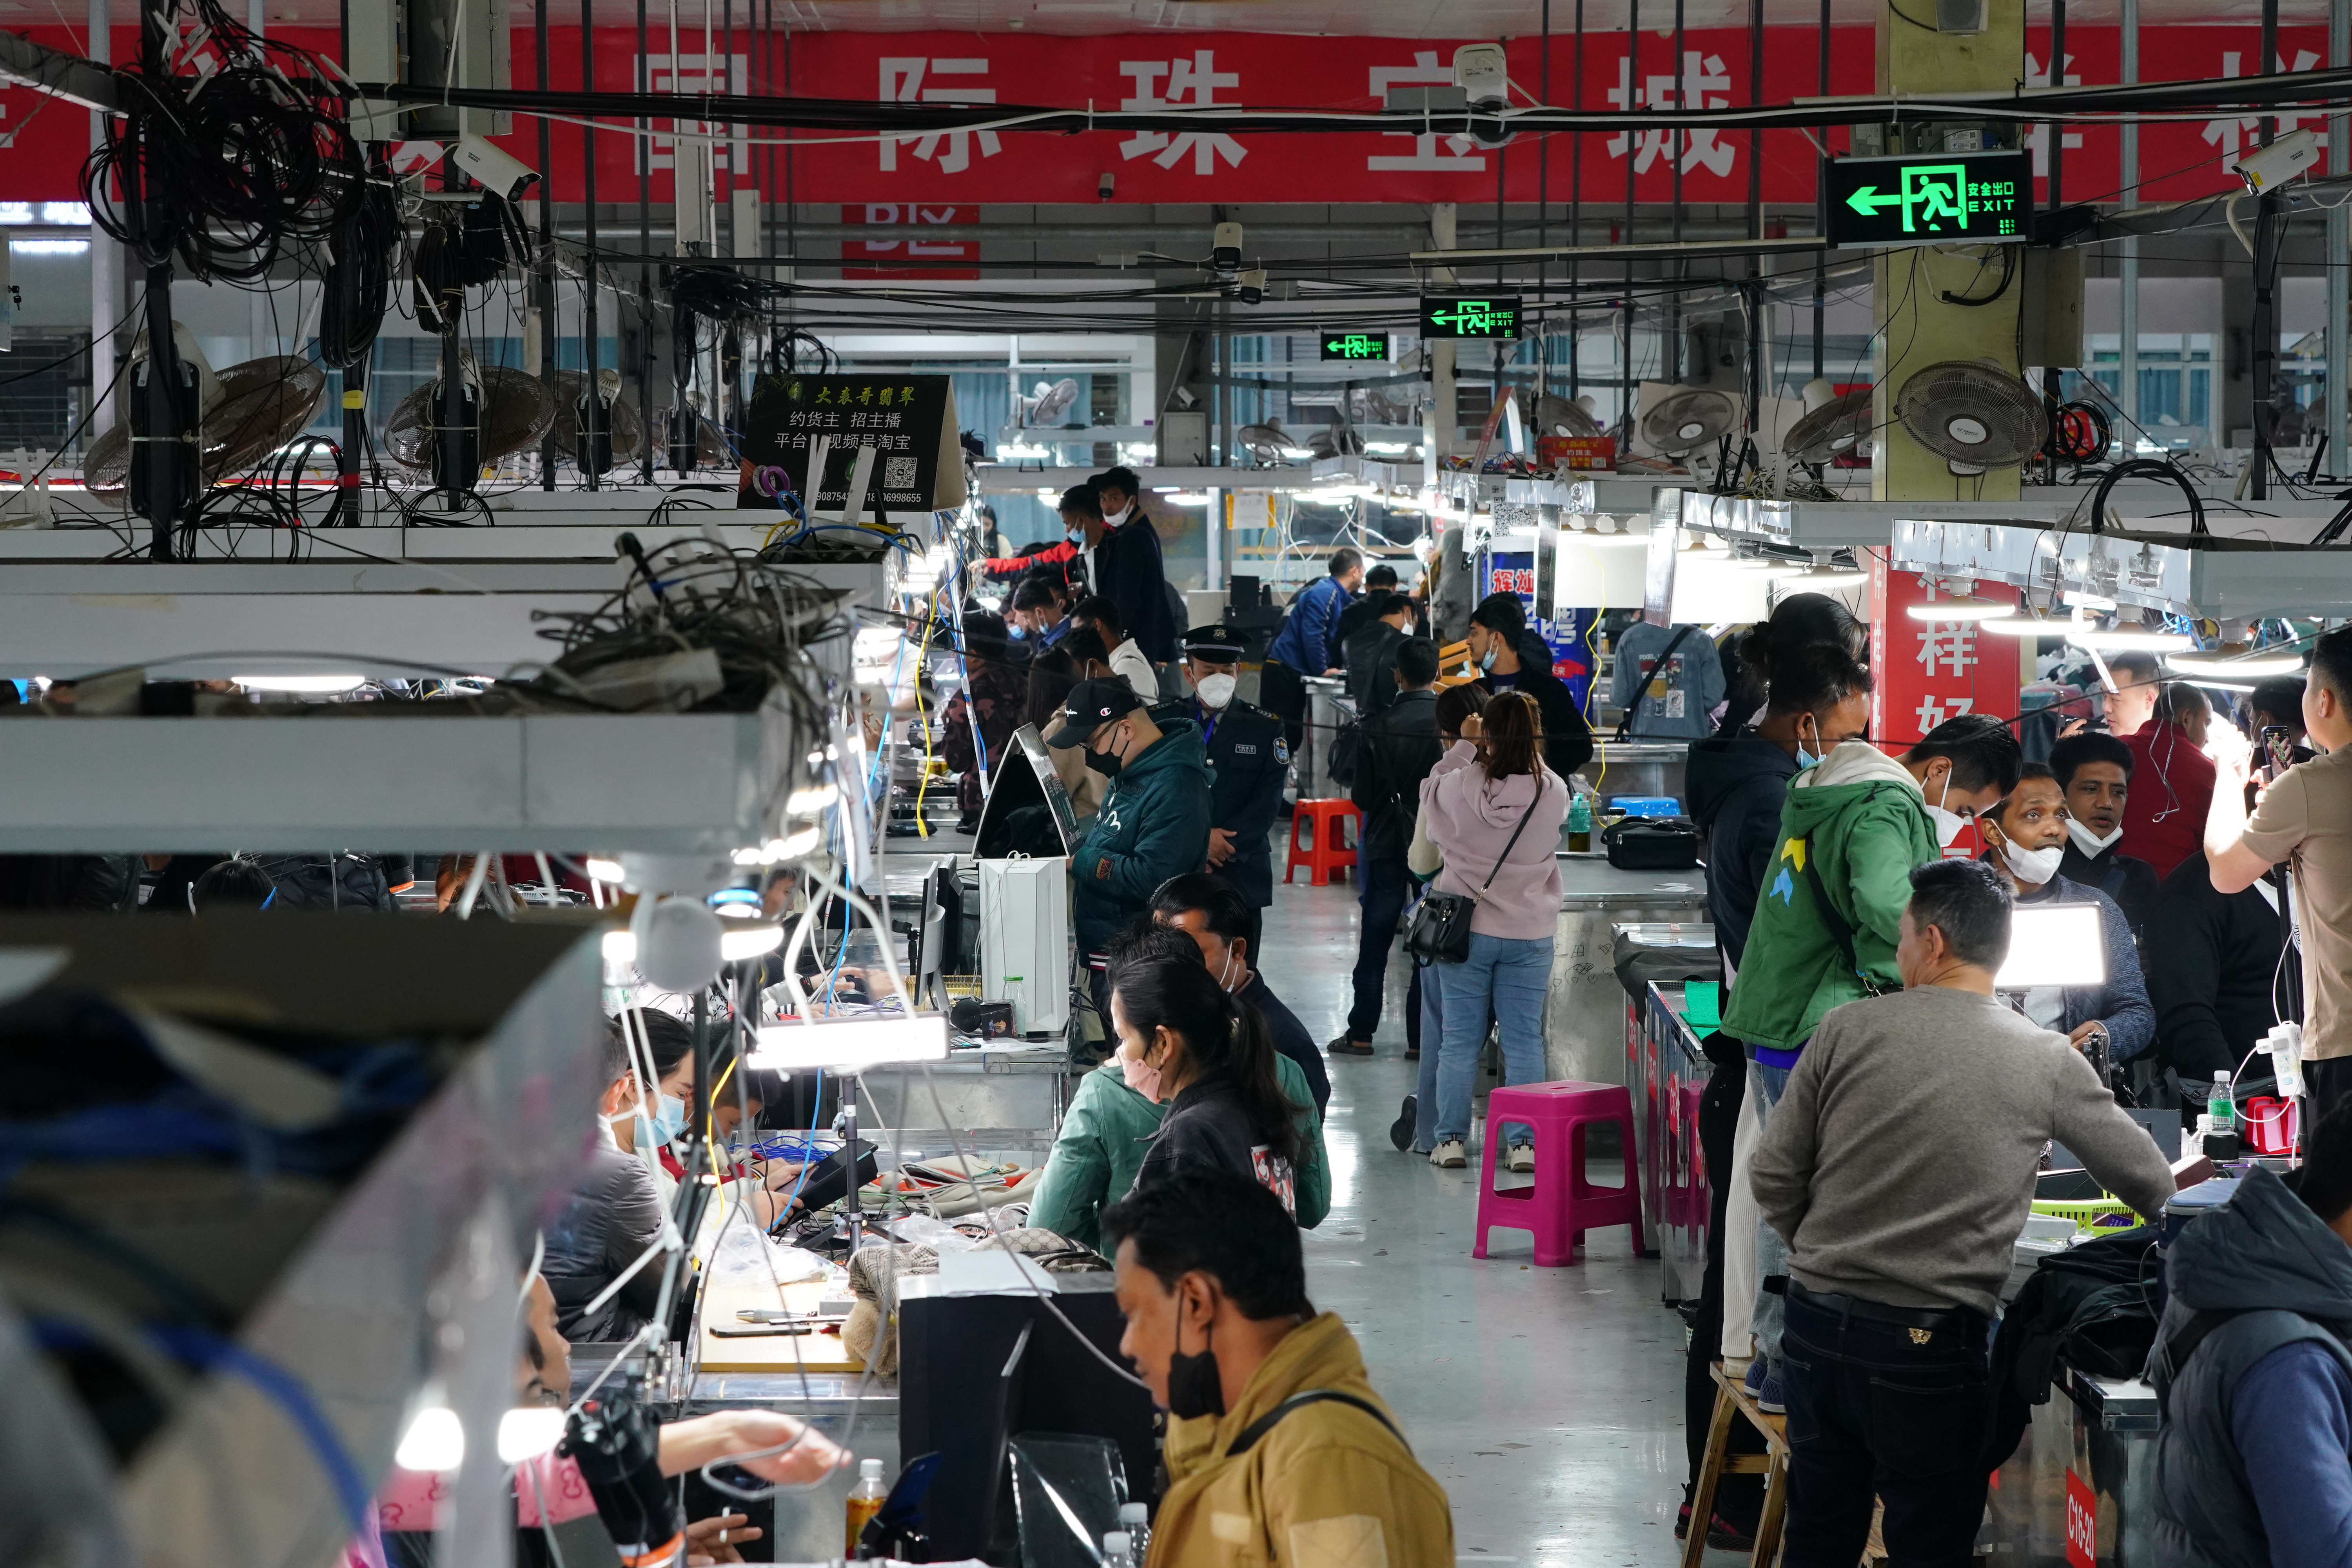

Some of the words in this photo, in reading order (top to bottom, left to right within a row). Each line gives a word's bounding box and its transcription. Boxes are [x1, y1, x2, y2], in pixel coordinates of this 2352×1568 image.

[1968, 181, 2014, 196] 安全出口
[1968, 199, 2015, 212] EXIT
[789, 411, 840, 427] 约货主
[850, 412, 901, 428] 招主播
[2068, 1494, 2094, 1561] C16-20
